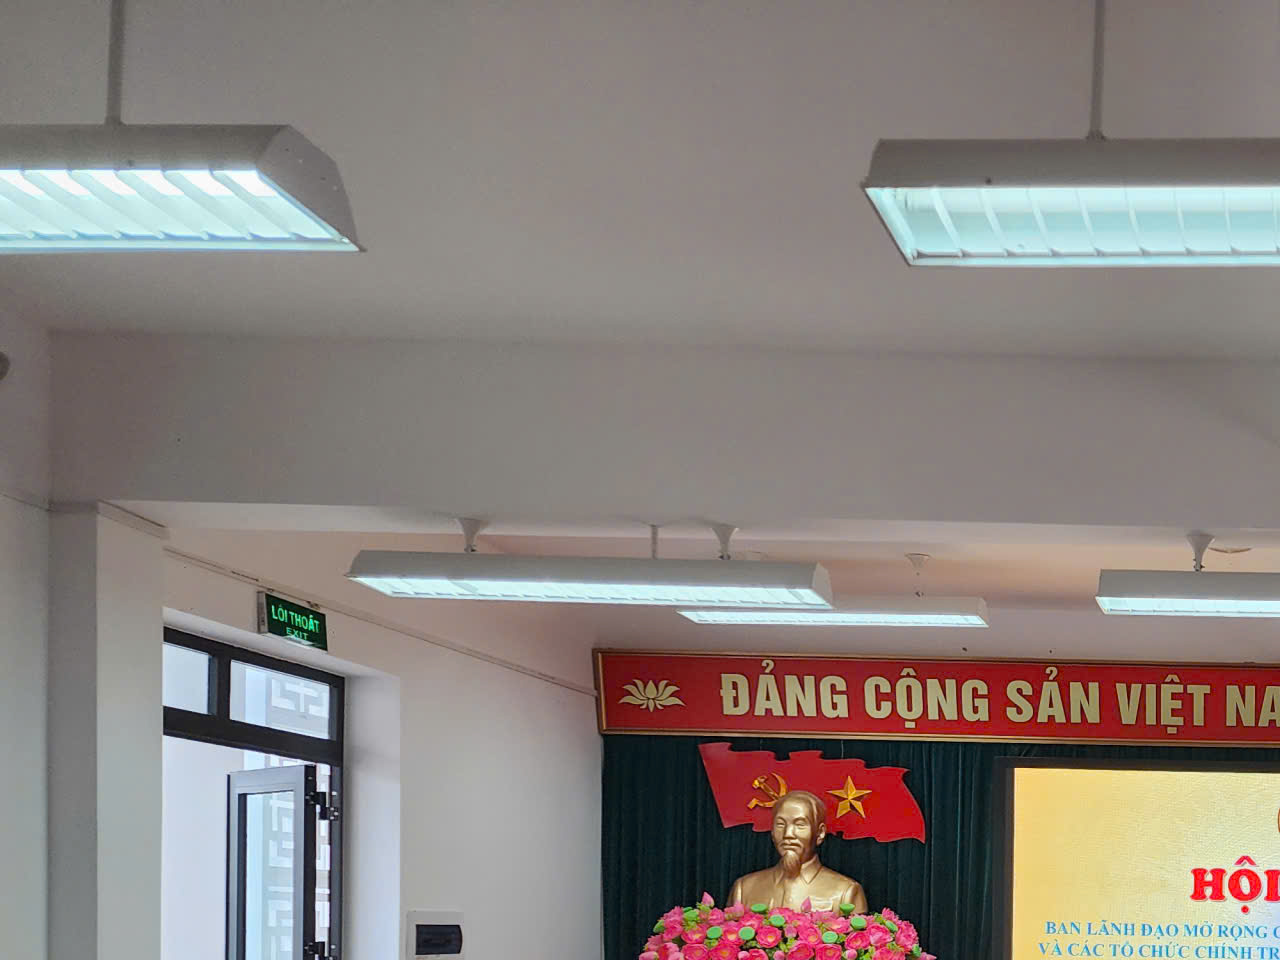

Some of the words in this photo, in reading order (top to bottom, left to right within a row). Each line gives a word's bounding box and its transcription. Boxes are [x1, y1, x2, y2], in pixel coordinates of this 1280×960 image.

[289, 611, 320, 633] THOÁT
[286, 627, 309, 641] EXIT
[720, 659, 848, 719] ĐẢNG
[864, 667, 989, 729] CỘNG
[1006, 666, 1100, 724] SẢN
[1117, 674, 1209, 734] VIỆT
[1045, 921, 1081, 935] BAN
[1087, 919, 1135, 936] LÃNH
[1141, 923, 1179, 940] ĐẠO
[1183, 920, 1214, 937] MỞ
[1217, 922, 1268, 941] RỘNG
[1039, 938, 1062, 956] VÀ
[1067, 939, 1105, 957] CÁC
[1109, 940, 1134, 957] TỔ
[1138, 941, 1190, 959] CHỨC
[1195, 942, 1252, 960] CHÍNH
